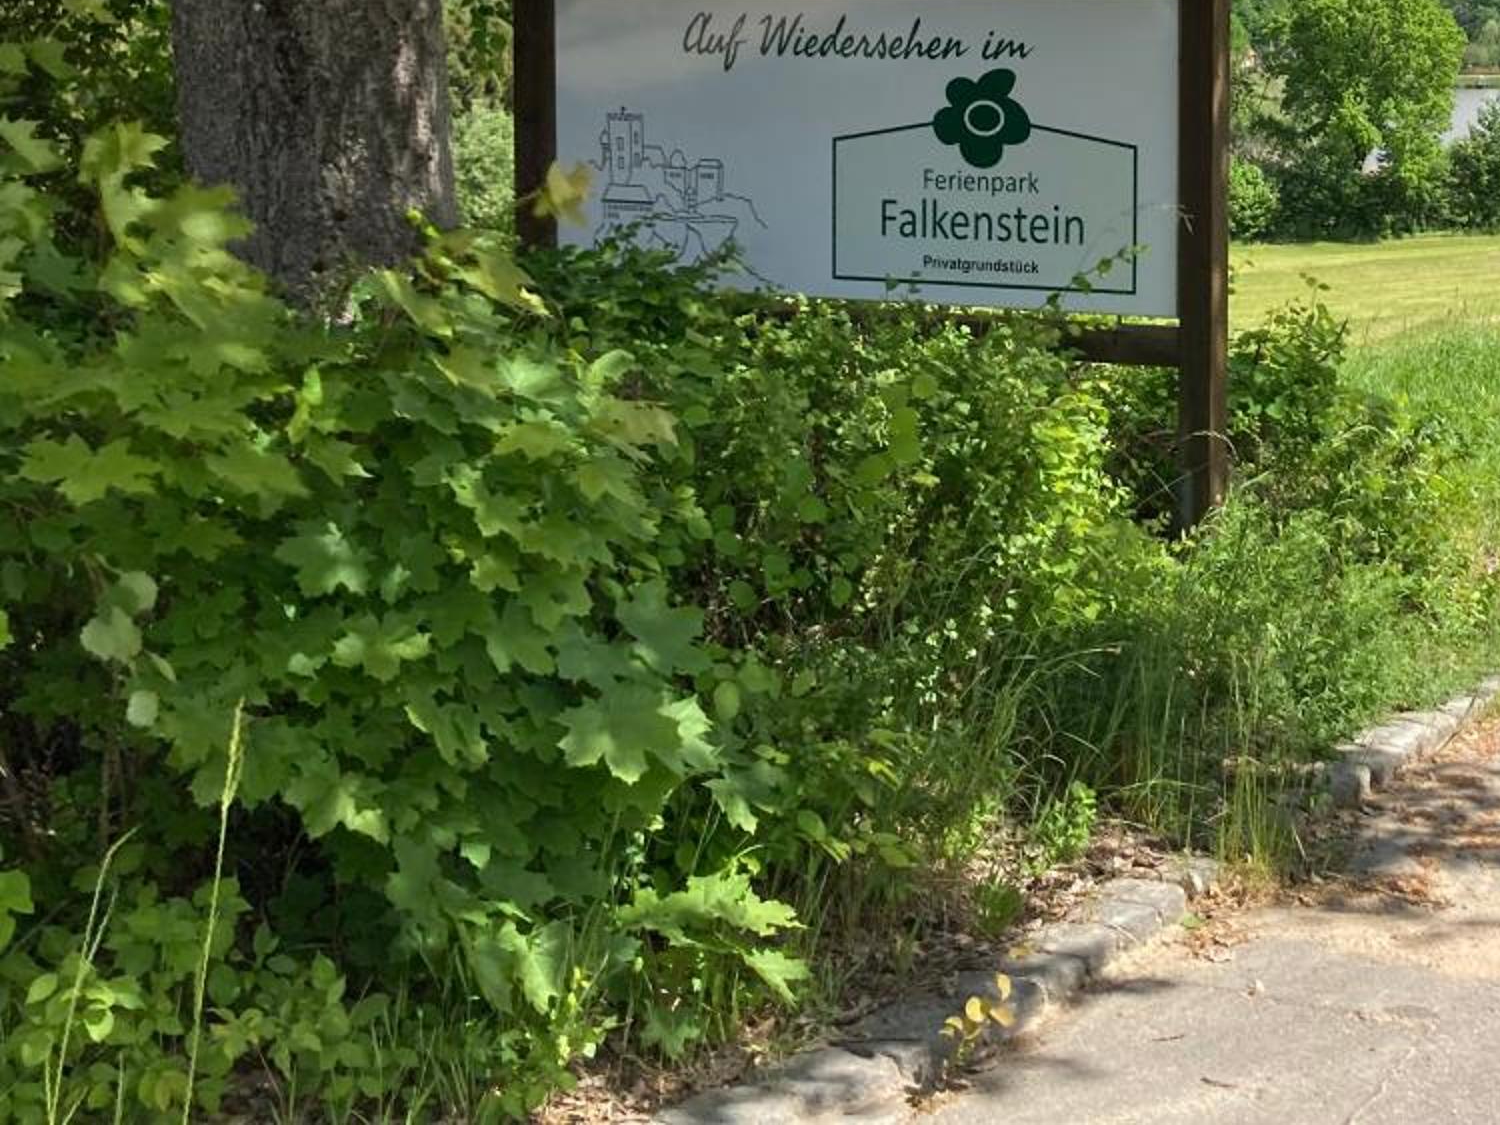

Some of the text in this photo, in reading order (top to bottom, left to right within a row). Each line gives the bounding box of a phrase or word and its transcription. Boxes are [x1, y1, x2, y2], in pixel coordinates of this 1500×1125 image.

[682, 12, 1034, 72] Auf Wiedersehen im
[922, 168, 1040, 196] Ferienpark
[881, 198, 1085, 246] Falkenstein
[922, 254, 1040, 275] Privatgrundstück
